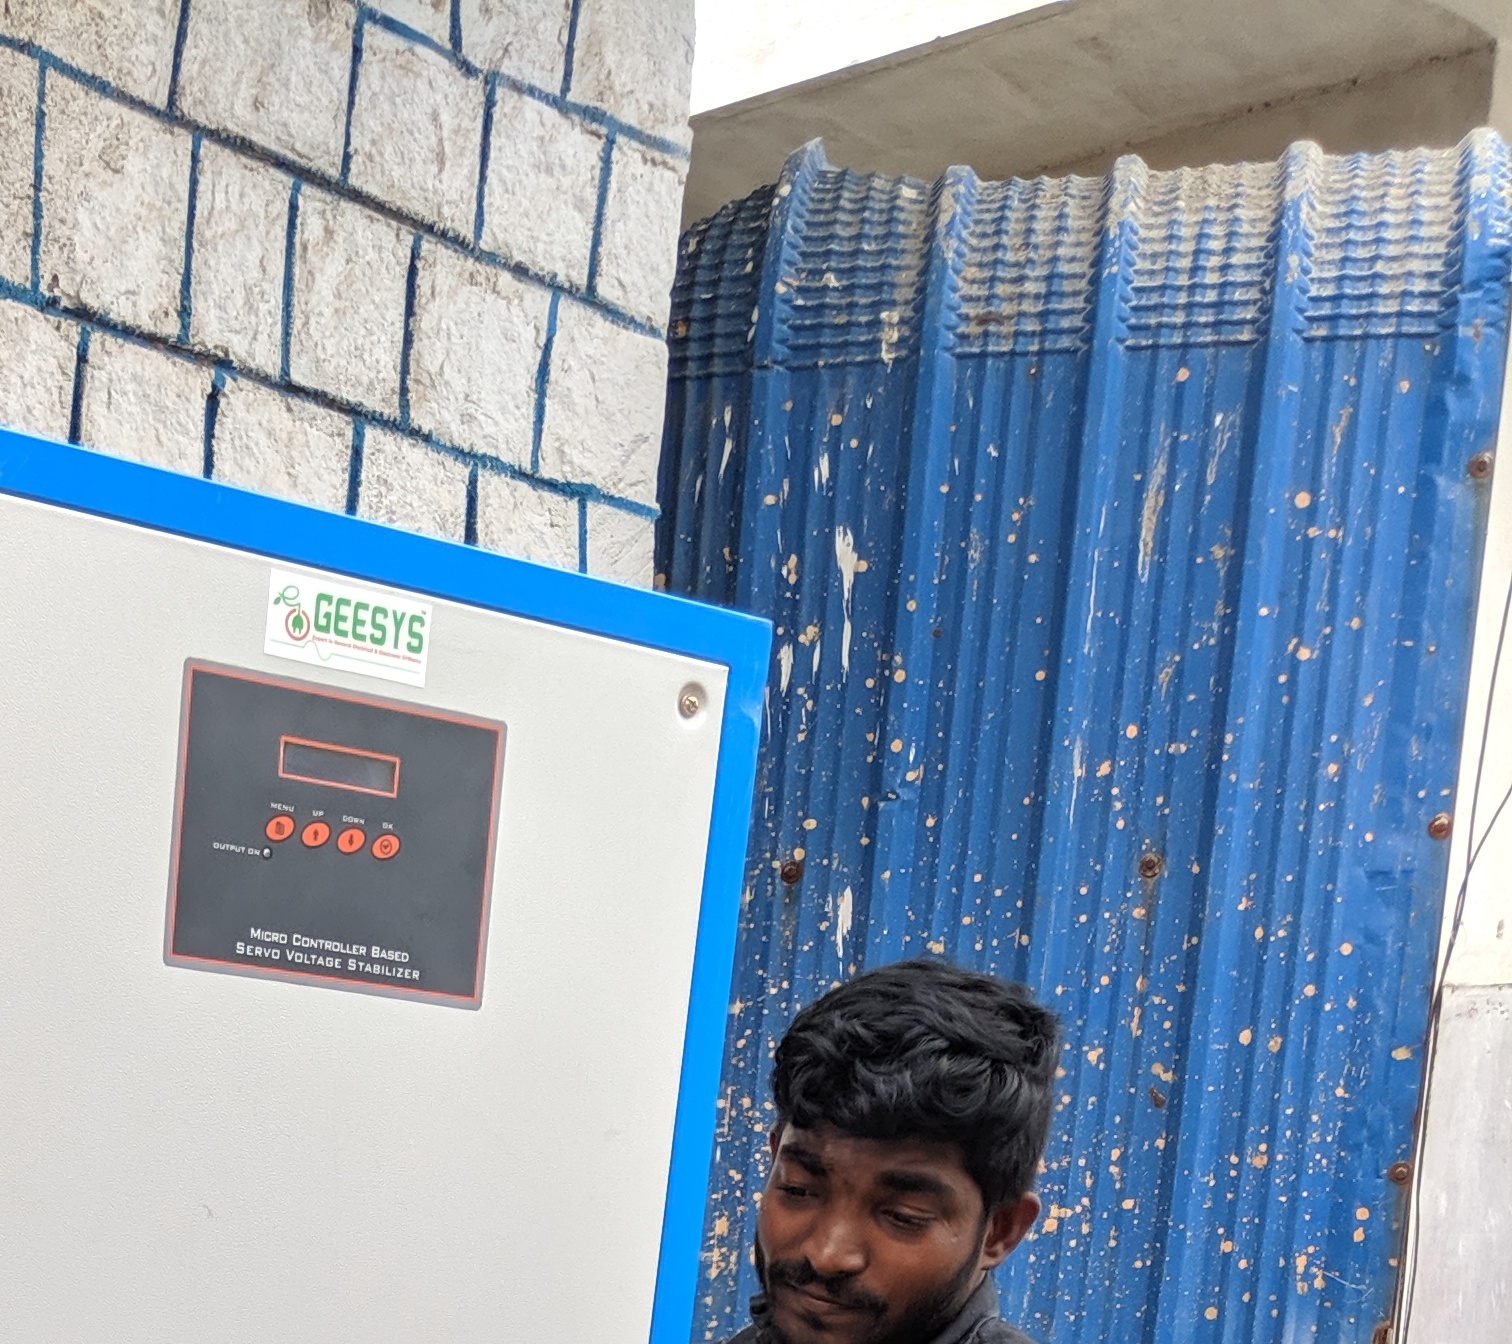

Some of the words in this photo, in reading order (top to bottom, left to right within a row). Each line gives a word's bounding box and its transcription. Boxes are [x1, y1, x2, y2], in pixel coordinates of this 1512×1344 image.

[314, 592, 425, 654] GEESYS
[270, 802, 295, 812] MENU
[342, 815, 365, 825] DOWN
[382, 822, 393, 830] OK
[212, 842, 246, 853] OUTPUT
[247, 848, 261, 856] ON
